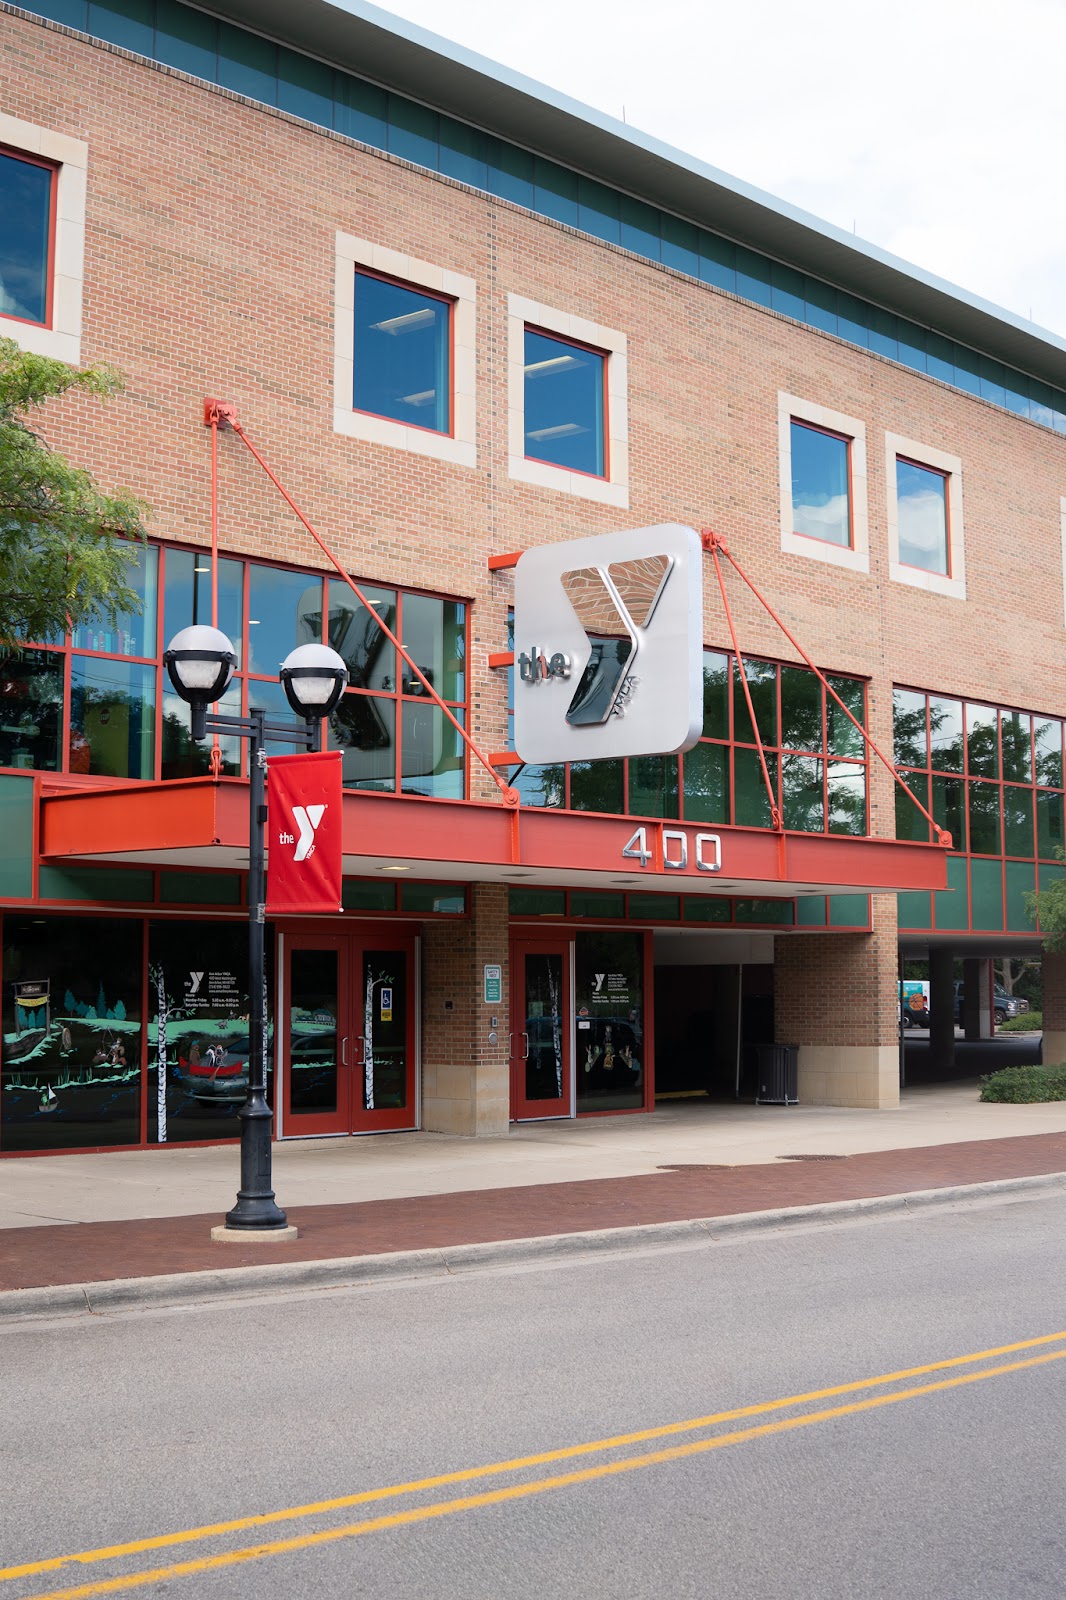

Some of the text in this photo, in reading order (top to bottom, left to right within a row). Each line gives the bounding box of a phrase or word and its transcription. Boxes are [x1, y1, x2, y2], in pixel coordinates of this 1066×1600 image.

[518, 646, 570, 681] the
[279, 832, 294, 845] the
[622, 827, 722, 872] 400
[305, 844, 316, 860] YMCA
